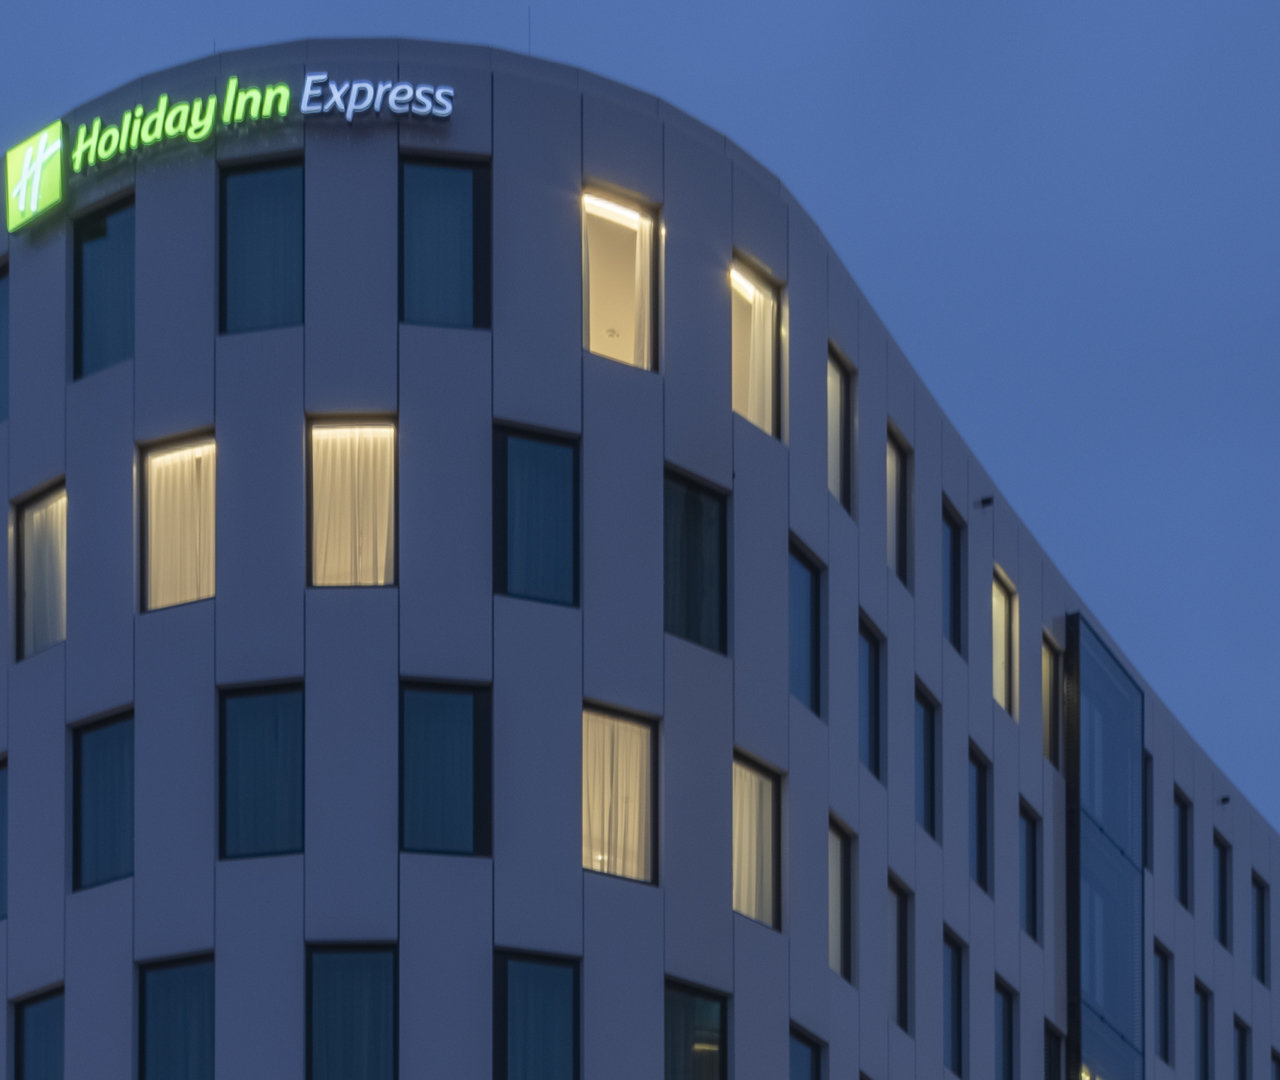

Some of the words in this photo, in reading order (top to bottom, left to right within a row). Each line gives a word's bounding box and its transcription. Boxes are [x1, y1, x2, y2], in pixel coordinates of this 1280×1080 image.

[72, 92, 217, 173] Holiday
[222, 74, 291, 126] Inn
[301, 71, 455, 122] Express
